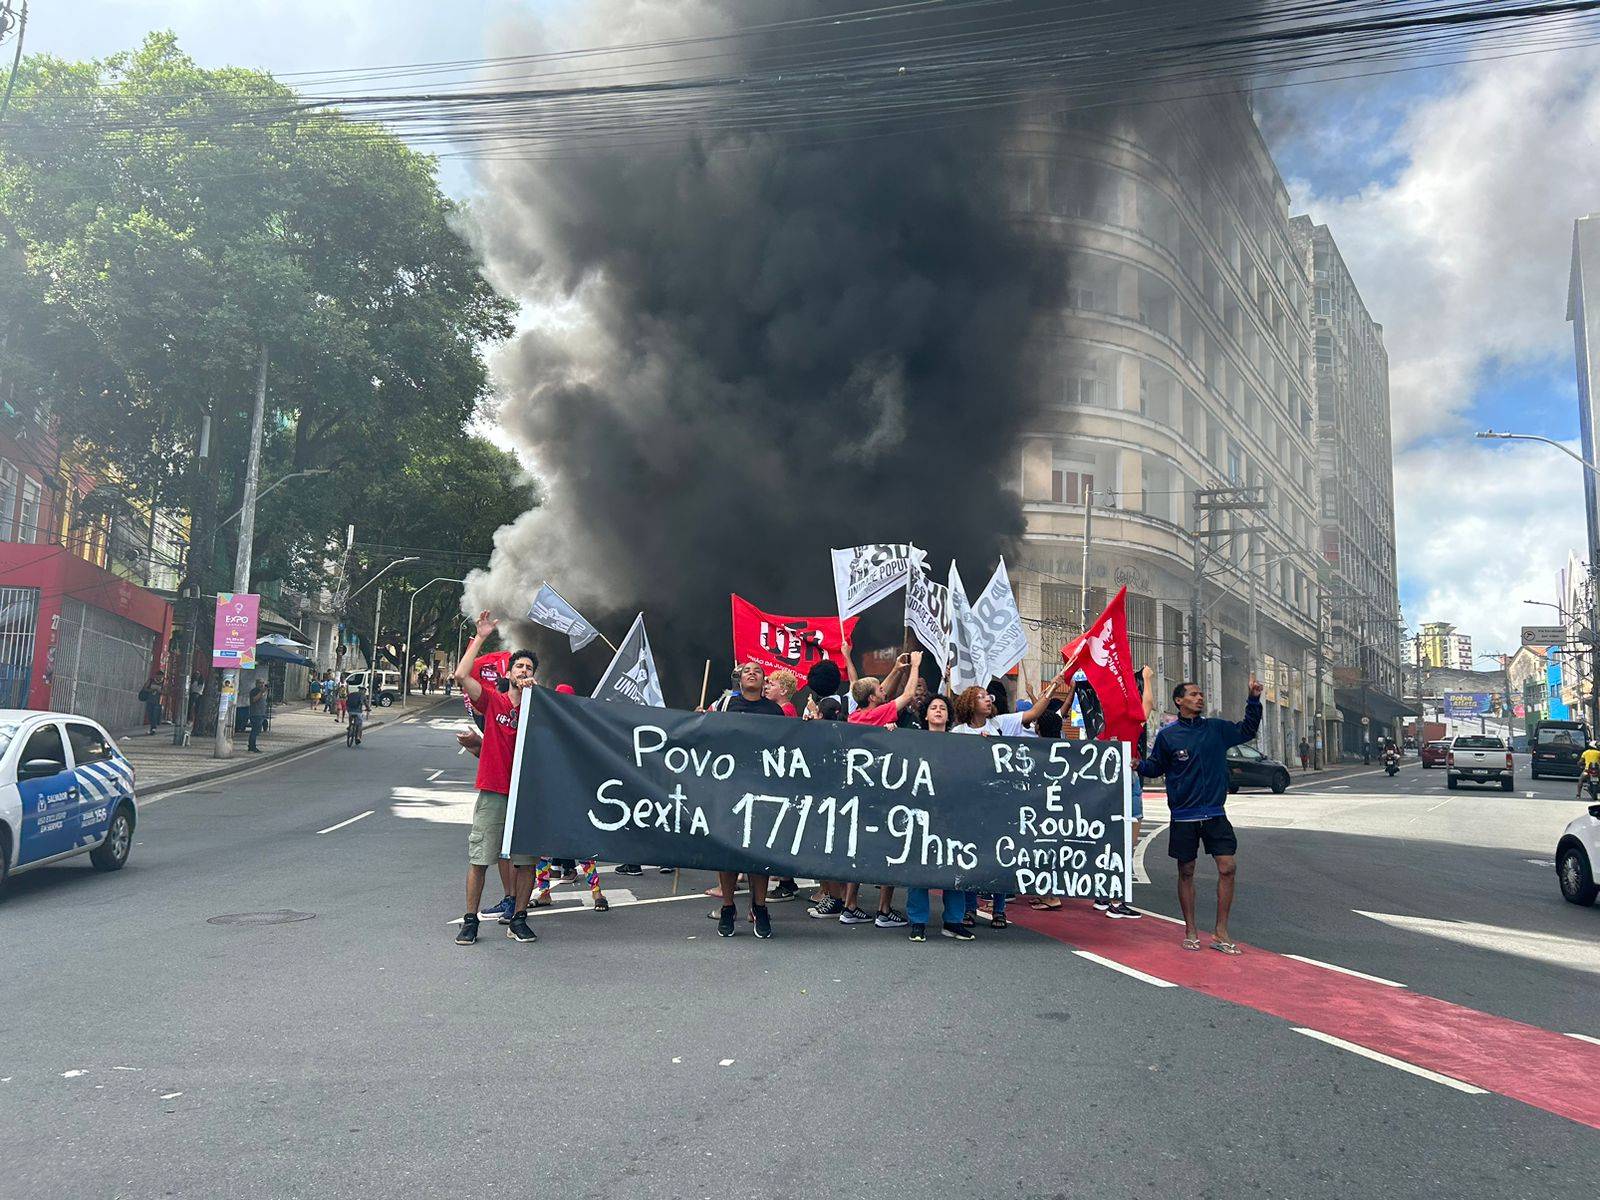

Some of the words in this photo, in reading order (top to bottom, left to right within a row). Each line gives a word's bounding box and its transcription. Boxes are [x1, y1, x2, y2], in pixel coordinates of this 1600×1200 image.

[225, 615, 249, 624] EXPO
[762, 745, 811, 778] NA
[847, 748, 935, 796] RUA
[992, 743, 1036, 777] R$
[1044, 742, 1122, 786] 5,20
[1046, 779, 1064, 812] É
[1020, 803, 1105, 838] Roubo
[1015, 868, 1123, 898] POLVORA
